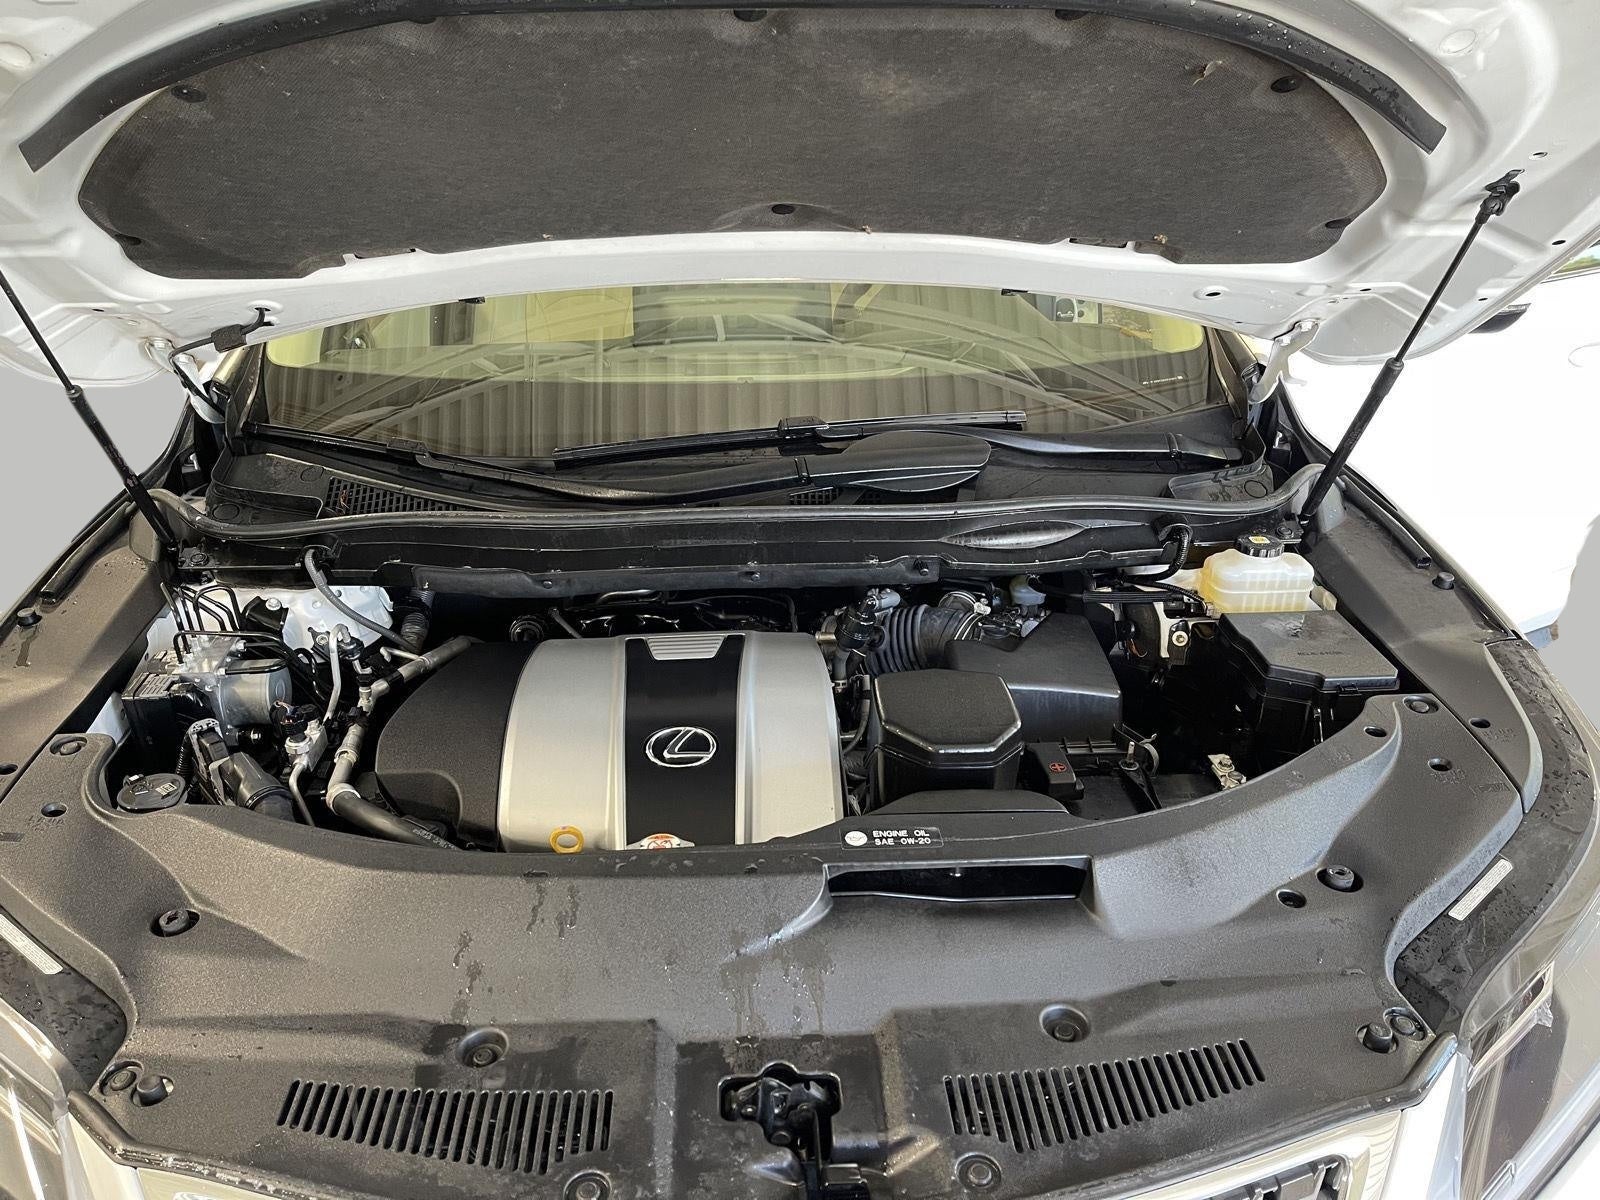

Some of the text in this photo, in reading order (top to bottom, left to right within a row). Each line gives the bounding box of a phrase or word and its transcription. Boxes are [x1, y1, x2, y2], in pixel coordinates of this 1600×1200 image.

[872, 829, 930, 838] ENGINE OIL
[874, 838, 895, 846] SAE
